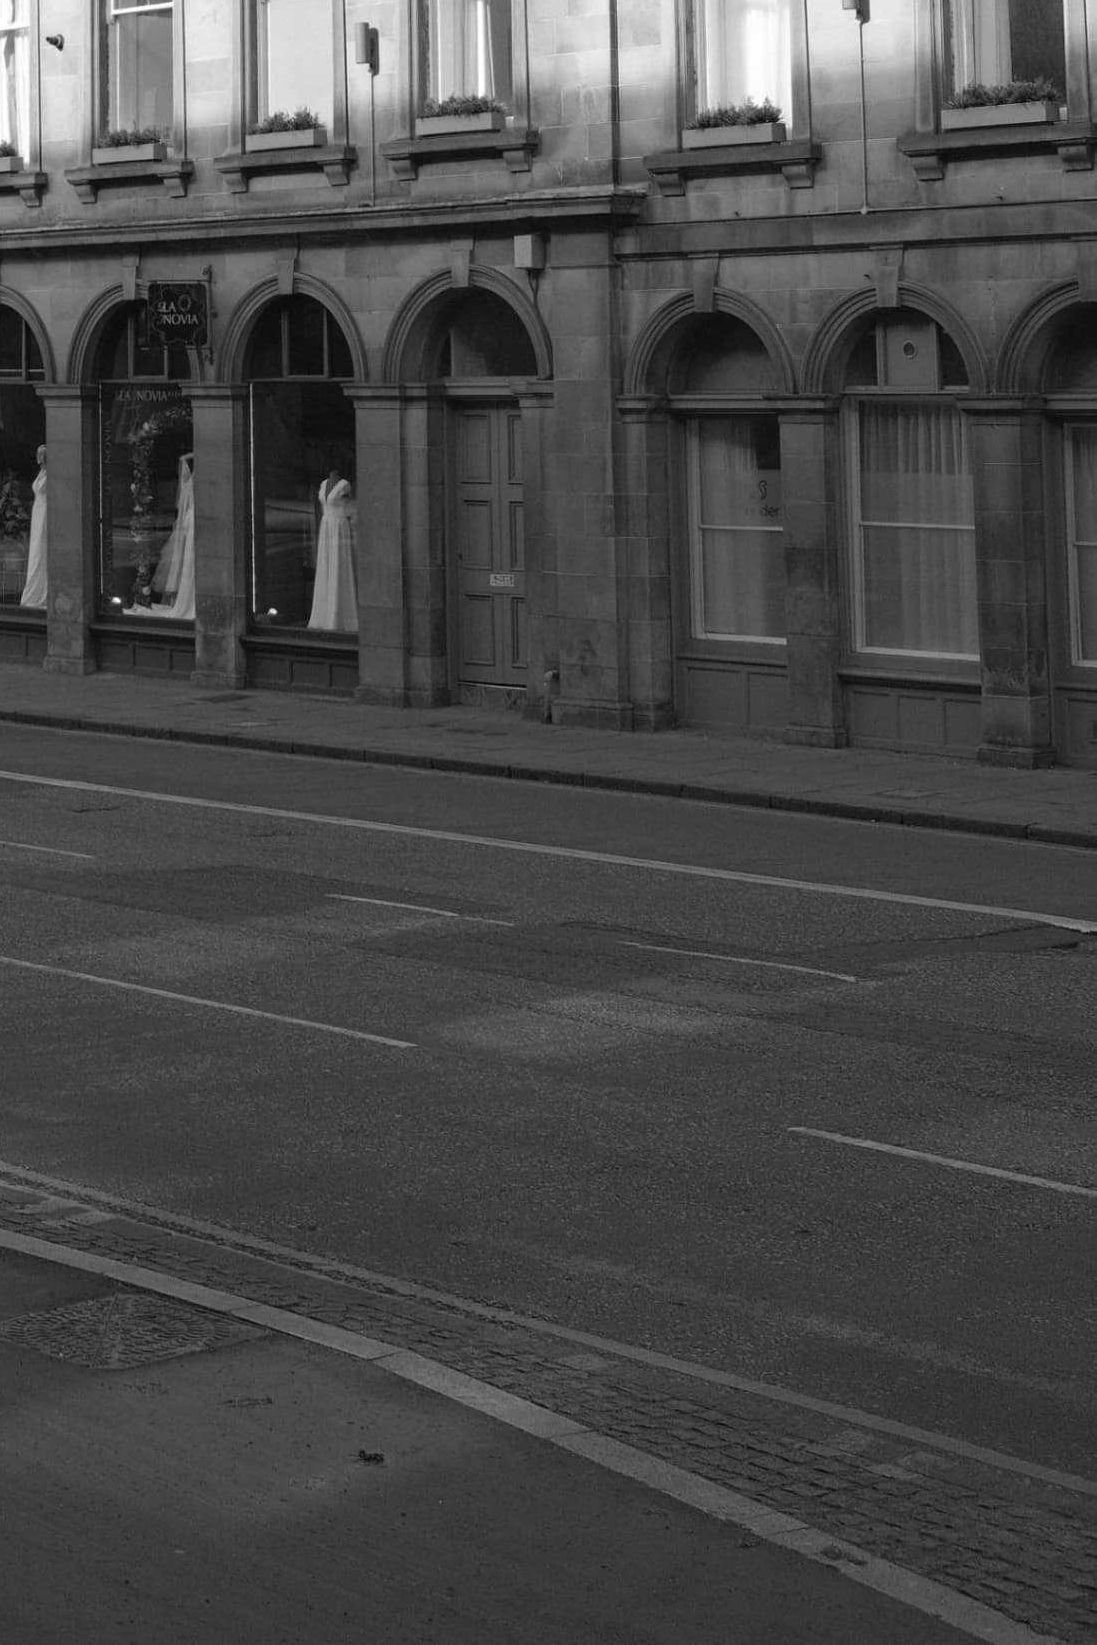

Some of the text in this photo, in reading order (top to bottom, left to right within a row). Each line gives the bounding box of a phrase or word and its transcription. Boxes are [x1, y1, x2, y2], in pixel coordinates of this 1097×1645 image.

[160, 301, 177, 313] LA
[162, 313, 199, 325] NOVIA
[118, 389, 132, 402] LA
[136, 389, 168, 402] NOVIA
